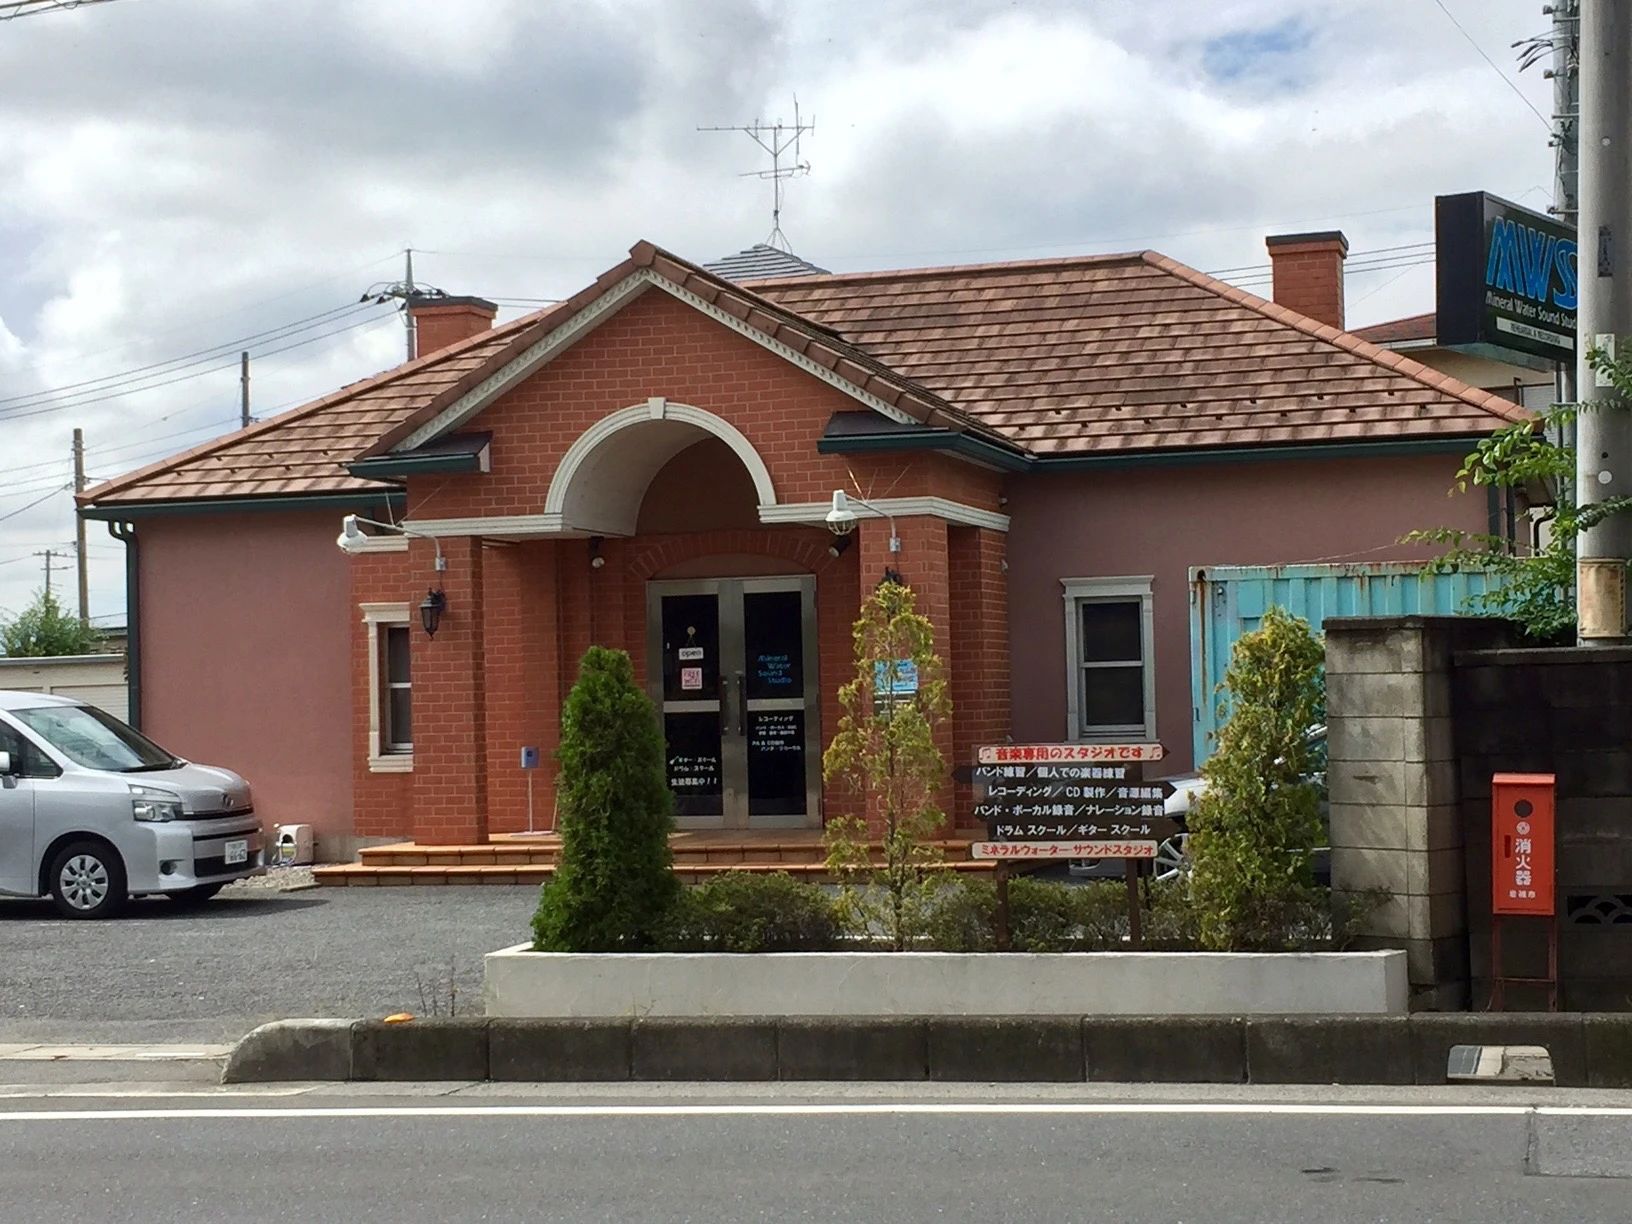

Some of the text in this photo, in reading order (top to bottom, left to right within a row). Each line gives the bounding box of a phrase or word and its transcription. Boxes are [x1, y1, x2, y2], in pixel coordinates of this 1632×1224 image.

[1485, 291, 1513, 312] Mineral
[1514, 299, 1536, 318] Water
[1538, 306, 1560, 325] Sound
[996, 746, 1144, 761] 音楽専用のスタジオです
[1514, 838, 1532, 886] 消火器
